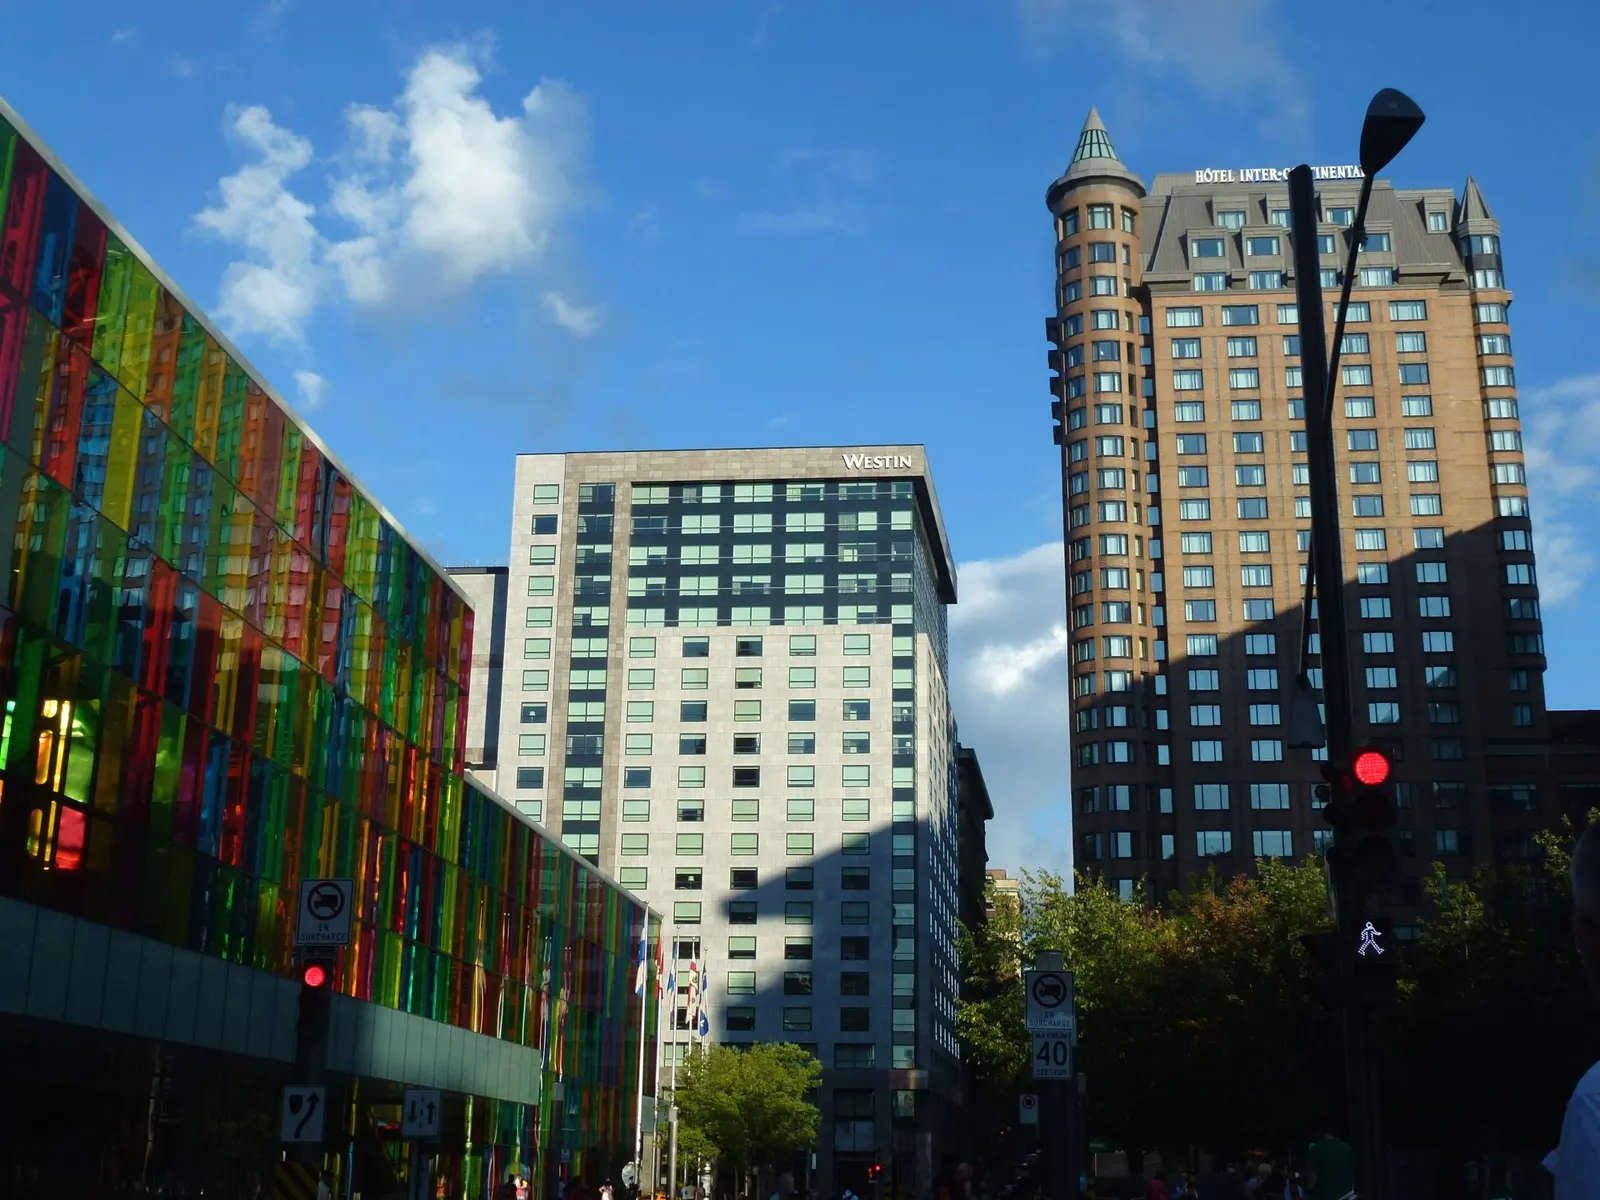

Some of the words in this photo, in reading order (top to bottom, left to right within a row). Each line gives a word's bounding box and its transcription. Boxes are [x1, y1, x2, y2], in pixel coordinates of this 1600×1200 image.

[1195, 168, 1235, 183] HÔTEL
[842, 454, 912, 469] WESTIN
[319, 924, 329, 932] EN
[300, 933, 346, 941] SURCHARGE
[1029, 1019, 1070, 1027] SURCHARGE
[1036, 1041, 1067, 1066] 40
